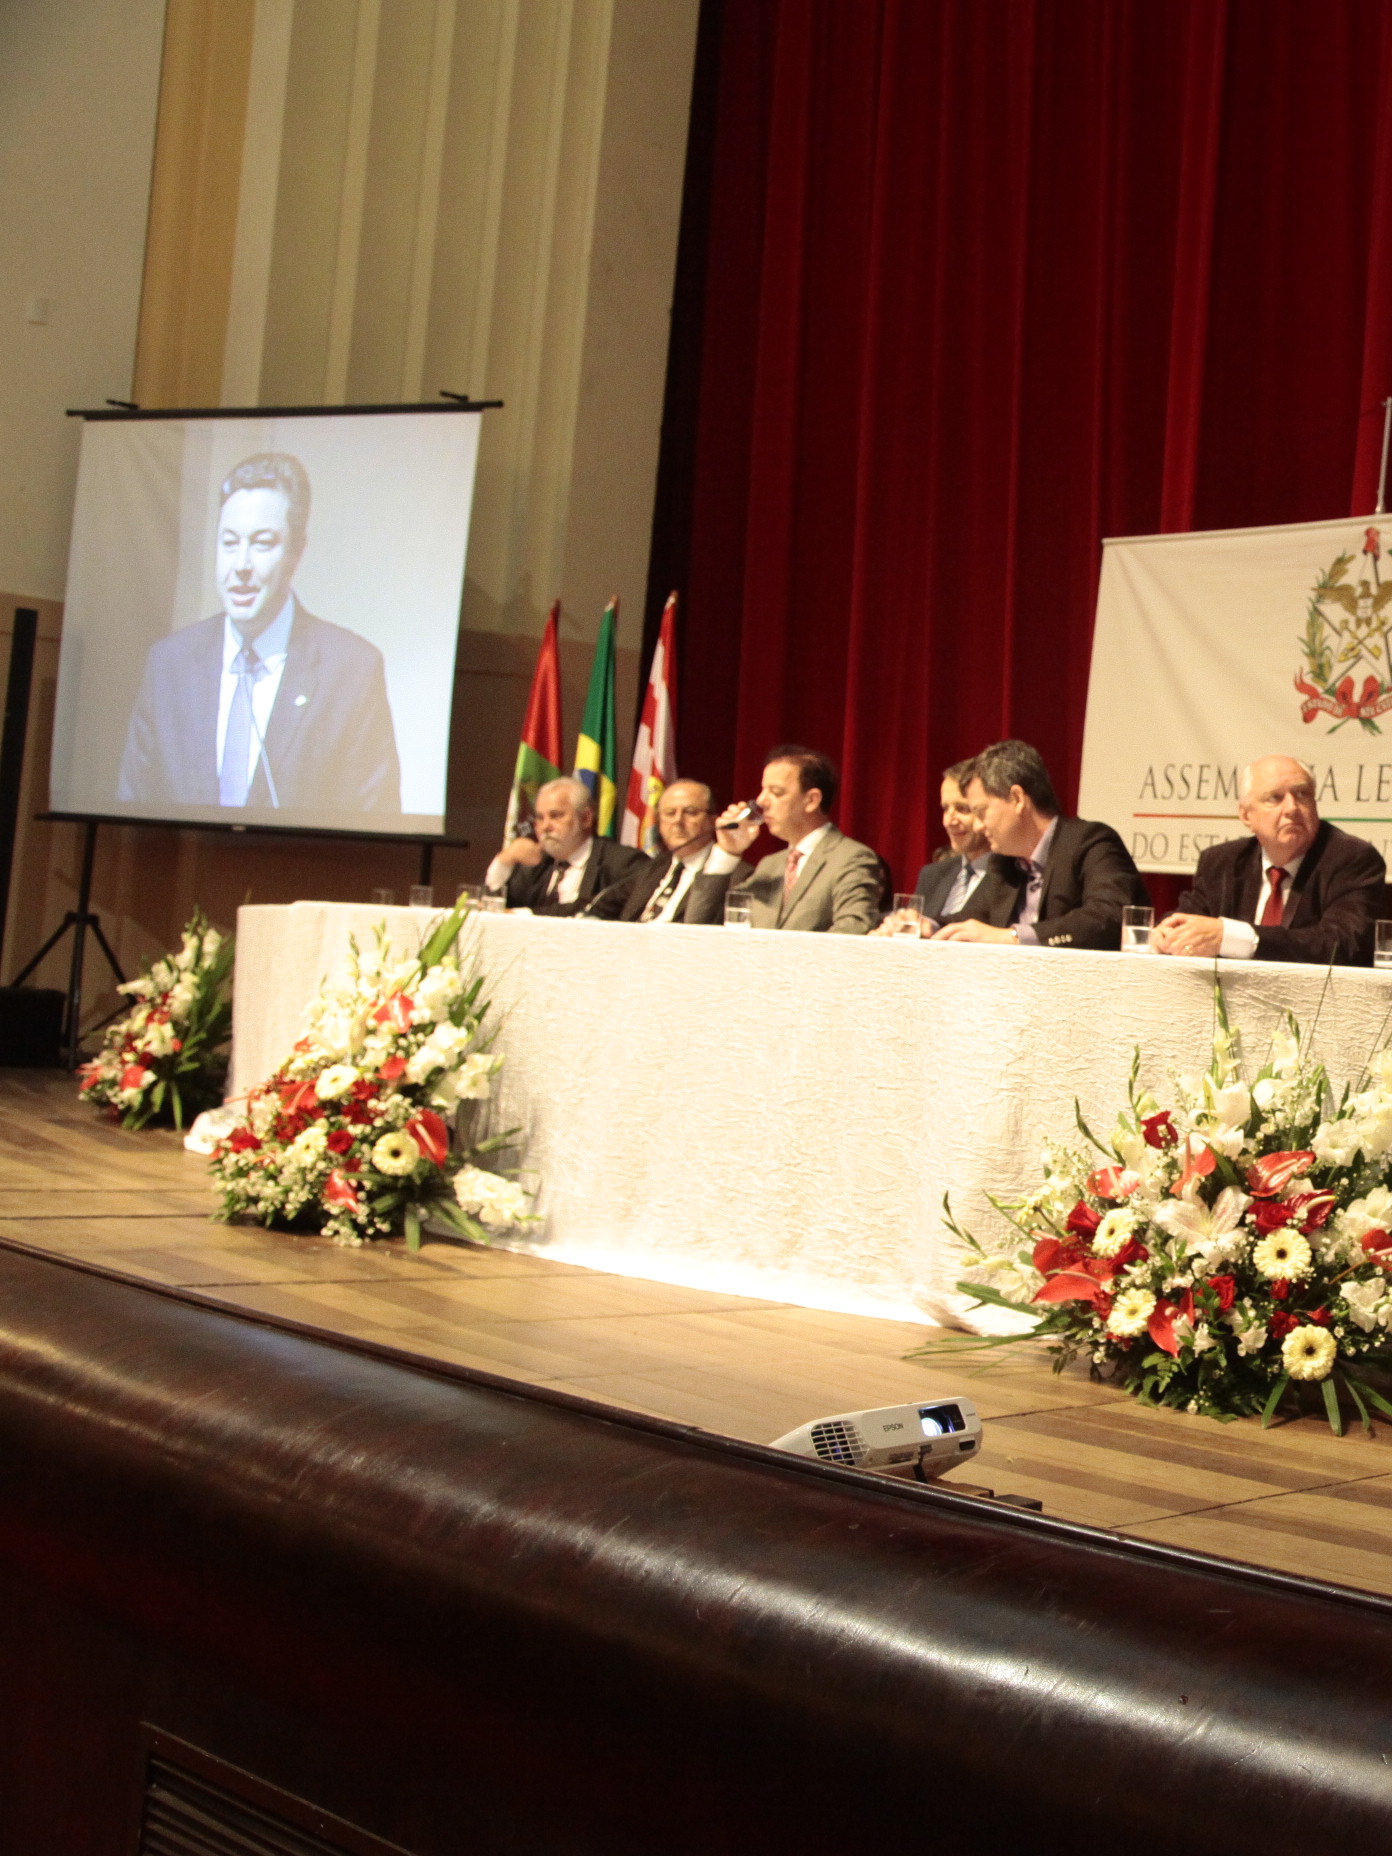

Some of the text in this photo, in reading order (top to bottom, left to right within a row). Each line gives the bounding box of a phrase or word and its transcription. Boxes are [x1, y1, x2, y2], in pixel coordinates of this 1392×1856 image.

[1138, 762, 1339, 803] ASSEMA
[1131, 832, 1169, 860] DO
[1178, 832, 1247, 862] EST
[883, 1423, 904, 1432] EPSON
